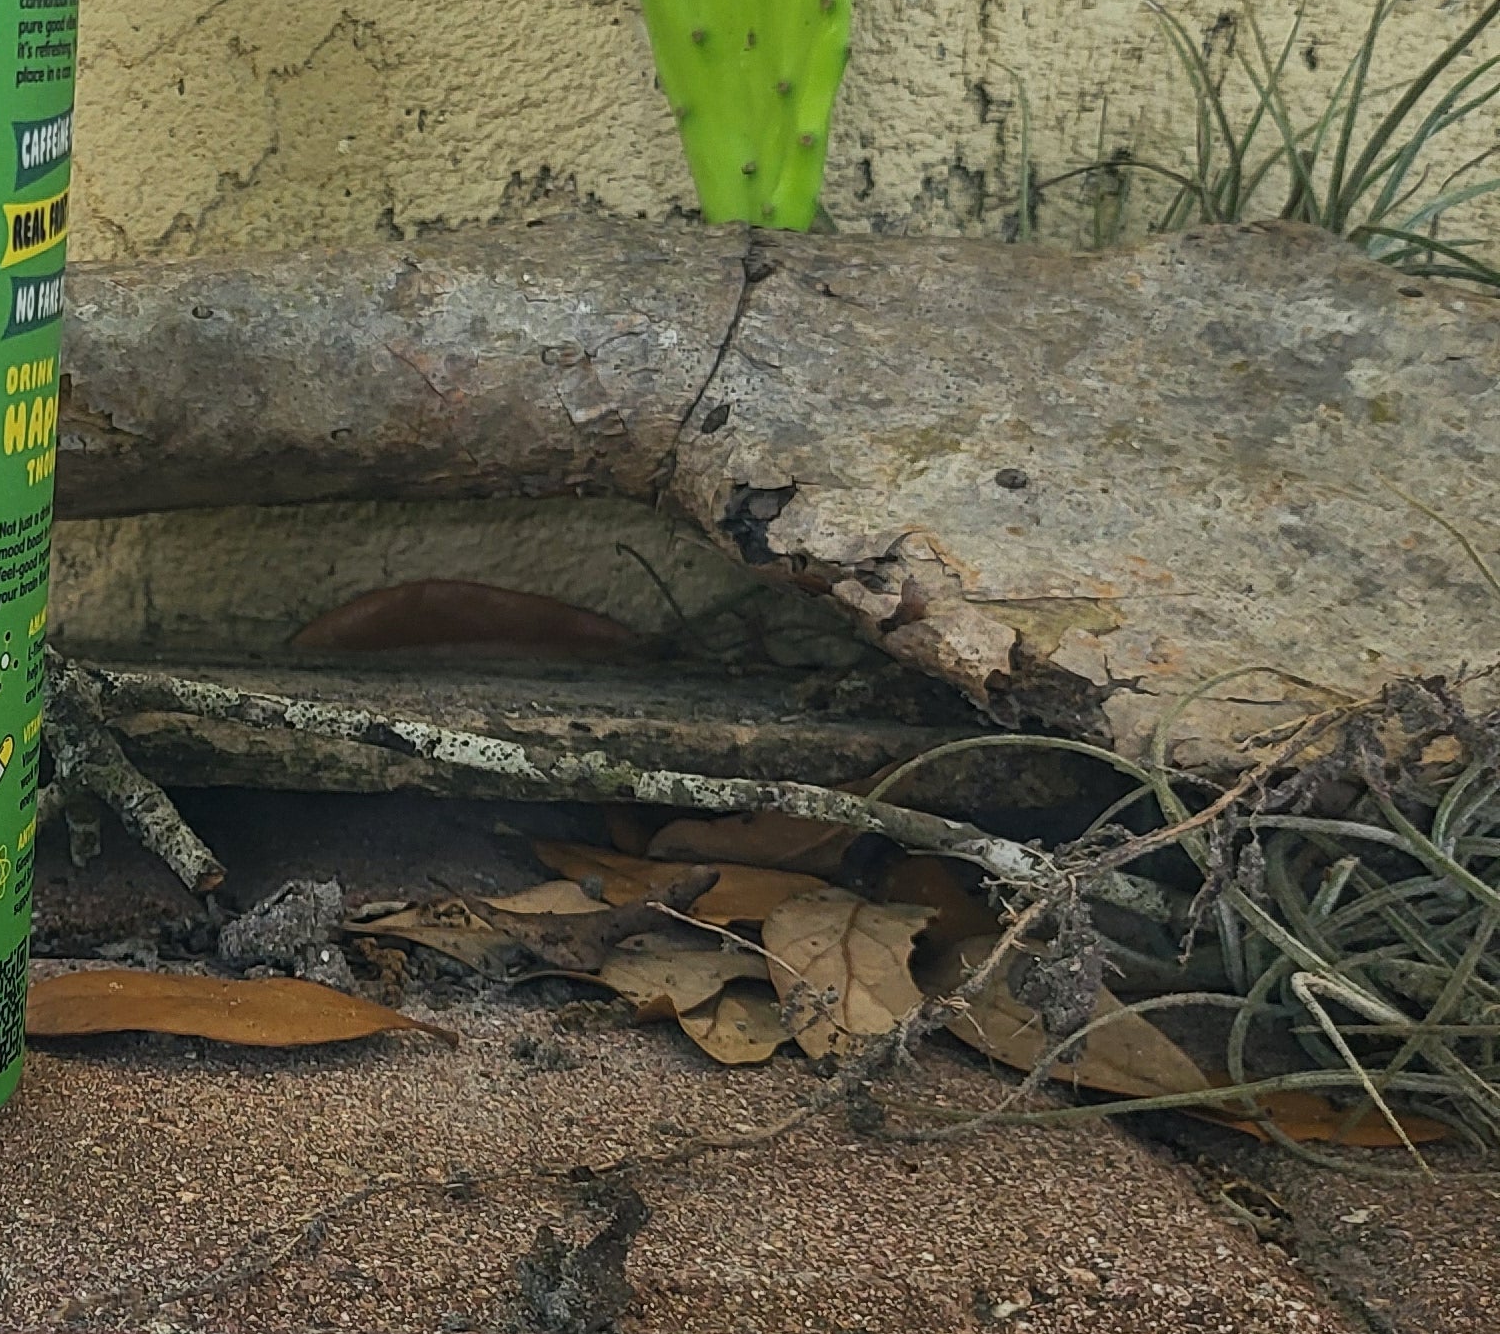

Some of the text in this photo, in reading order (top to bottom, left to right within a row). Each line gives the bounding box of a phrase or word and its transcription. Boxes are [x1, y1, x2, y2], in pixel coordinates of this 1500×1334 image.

[12, 207, 45, 252] REAL
[16, 280, 59, 324] NO FAKE
[6, 357, 54, 395] DRINK
